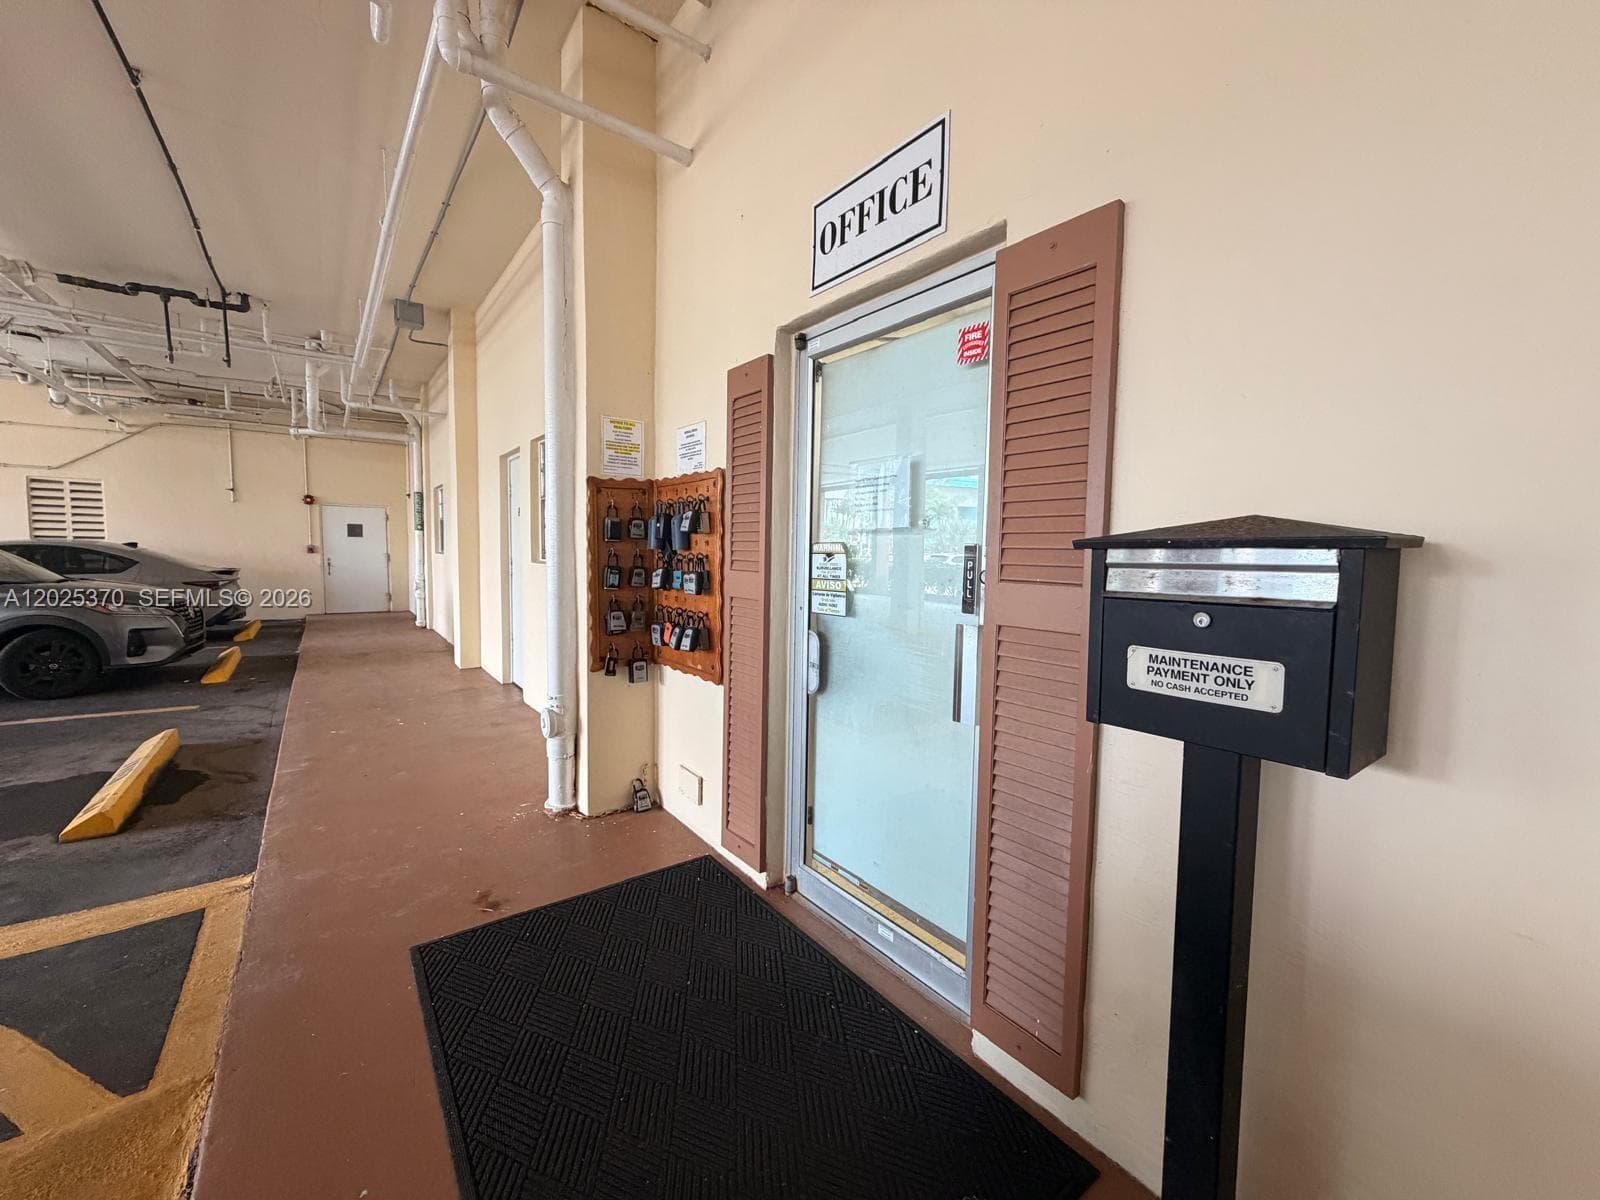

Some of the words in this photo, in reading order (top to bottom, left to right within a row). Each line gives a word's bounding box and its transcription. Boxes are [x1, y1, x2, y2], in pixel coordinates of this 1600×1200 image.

[820, 158, 932, 255] OFFICE
[964, 330, 983, 342] FIRE
[815, 581, 842, 590] AVISO
[1148, 653, 1254, 678] MAINTENANCE
[1146, 666, 1210, 684] PAYMENT
[1214, 676, 1256, 691] ONLY
[1150, 679, 1164, 689] NO
[1166, 681, 1191, 693] CASH
[1193, 687, 1249, 702] ACCEPTED
